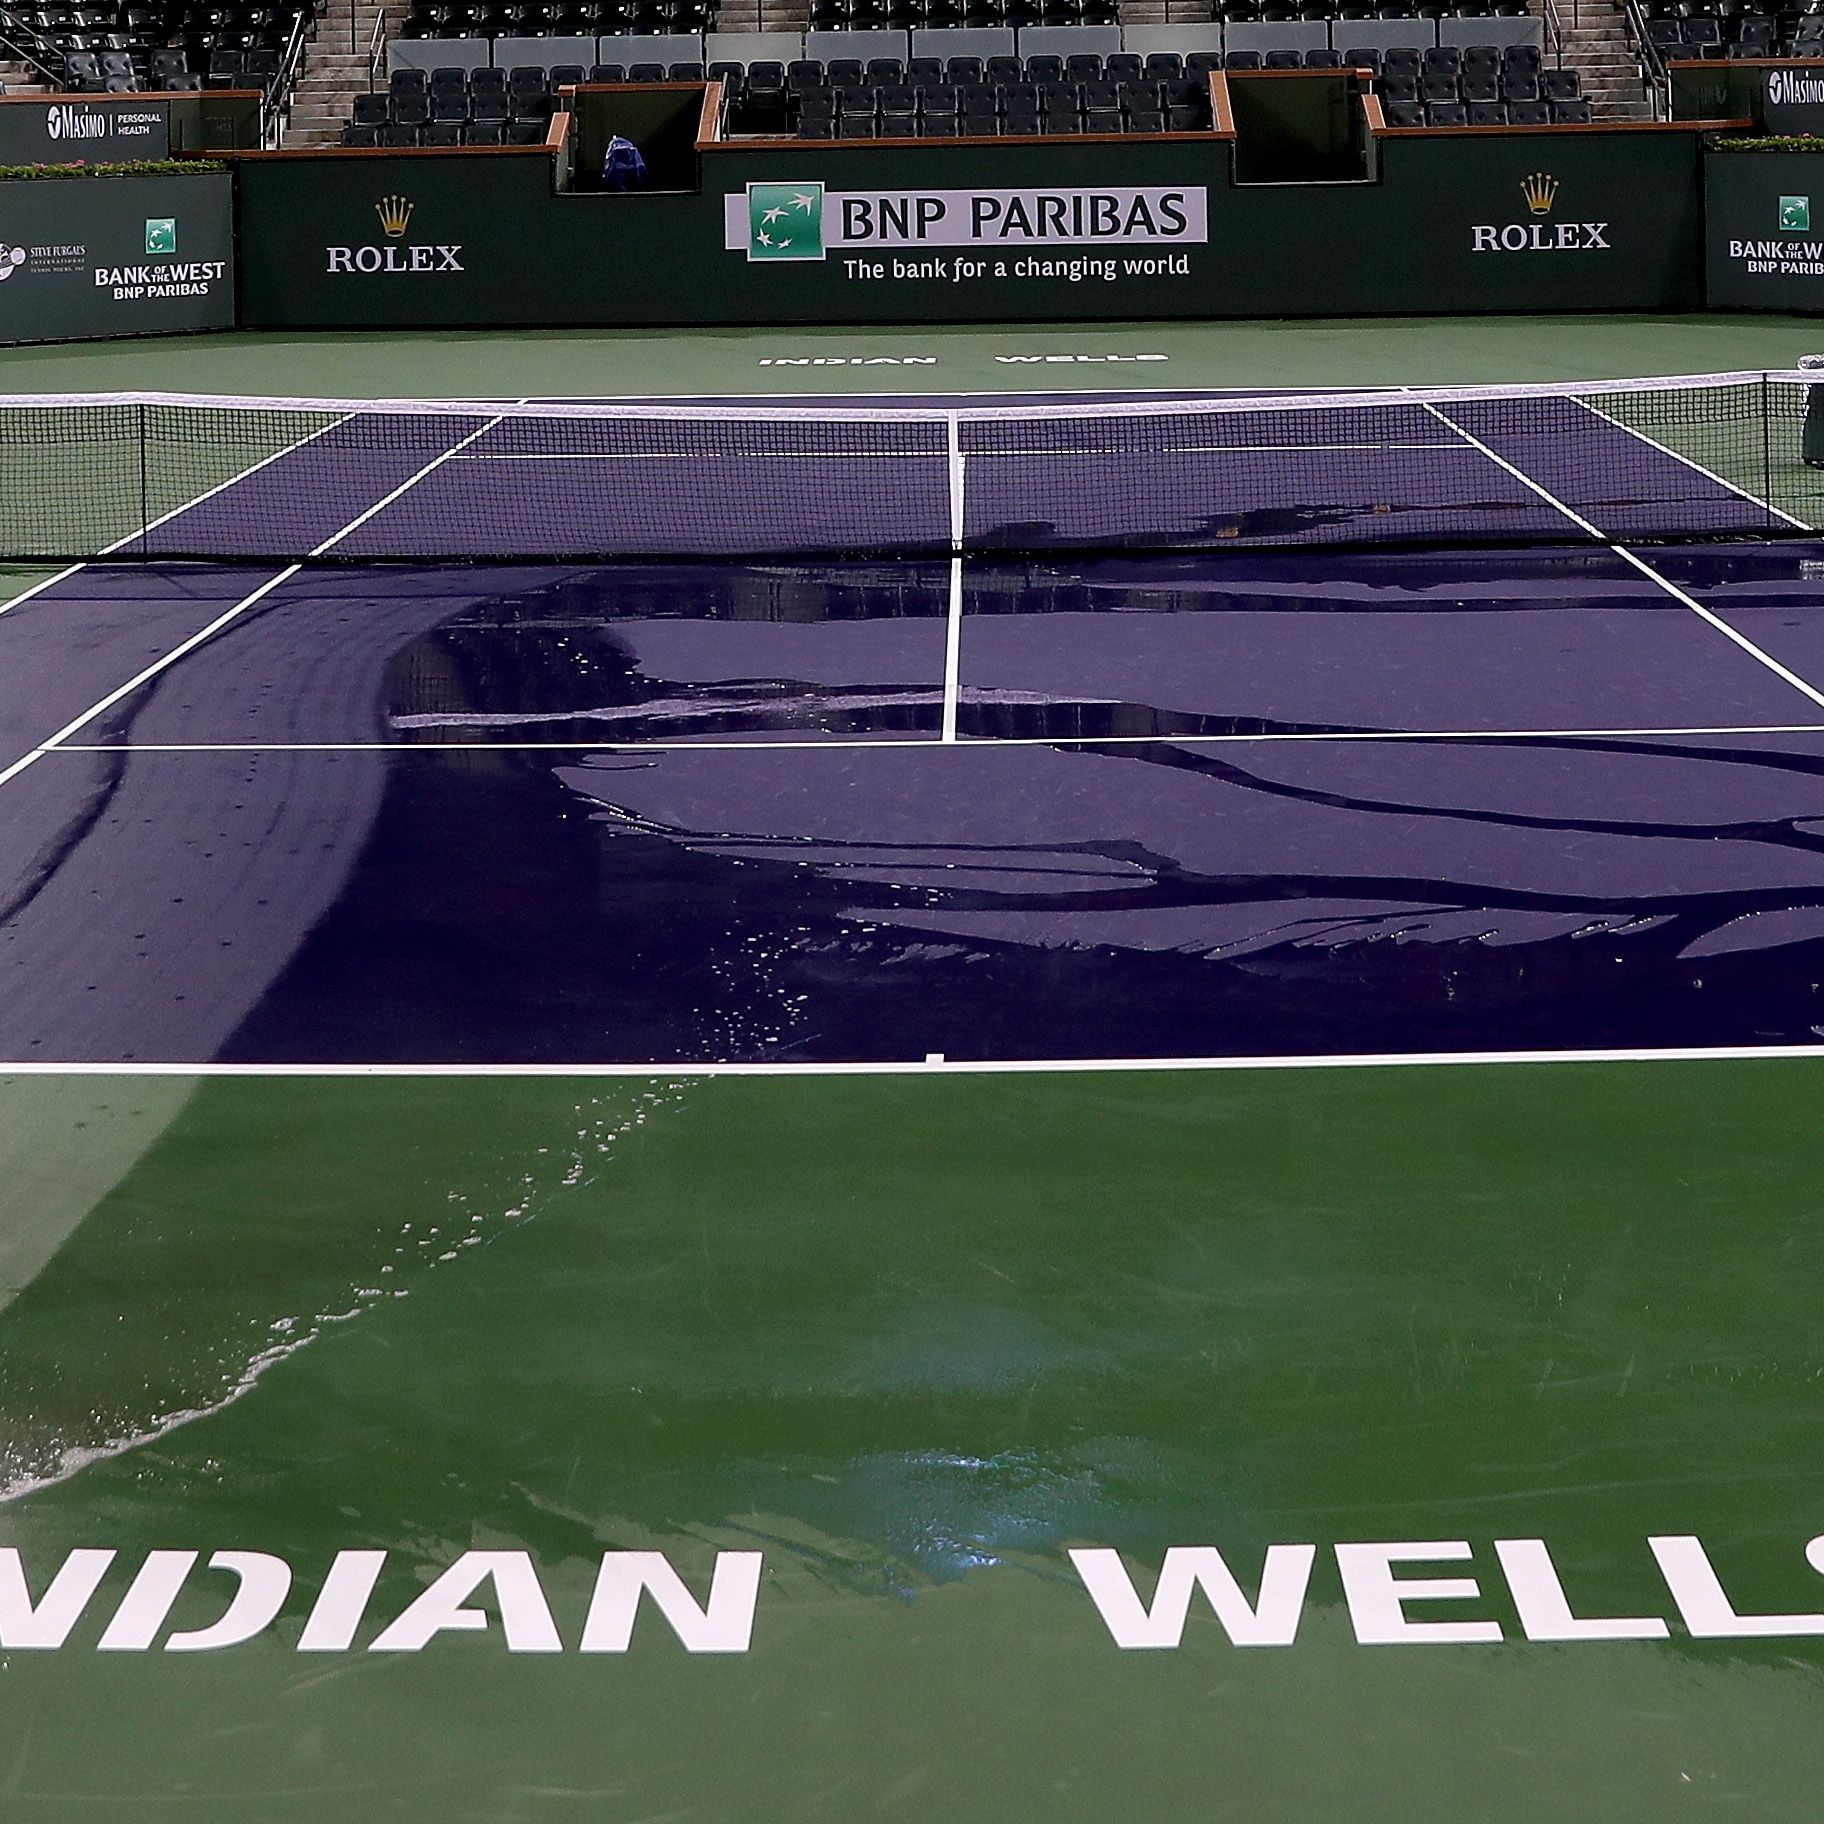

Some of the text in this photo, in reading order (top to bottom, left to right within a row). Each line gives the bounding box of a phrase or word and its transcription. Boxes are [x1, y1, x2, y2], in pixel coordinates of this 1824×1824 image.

[117, 113, 162, 124] PERSONAL
[117, 125, 150, 136] HEALTH
[841, 192, 1188, 240] BNP PARIBAS
[1472, 222, 1611, 252] ROLEX
[30, 246, 51, 257] STEVE
[1729, 240, 1784, 259] BANK
[1787, 242, 1801, 251] OF
[326, 244, 464, 273] ROLEX
[1784, 250, 1804, 260] THE
[94, 261, 226, 287] BANK OF THE WEST
[844, 253, 1190, 283] The bank for a changing world
[1748, 260, 1777, 273] BNP
[113, 282, 209, 300] BNP PARIBAS
[759, 352, 1169, 367] INDIAN WELLS
